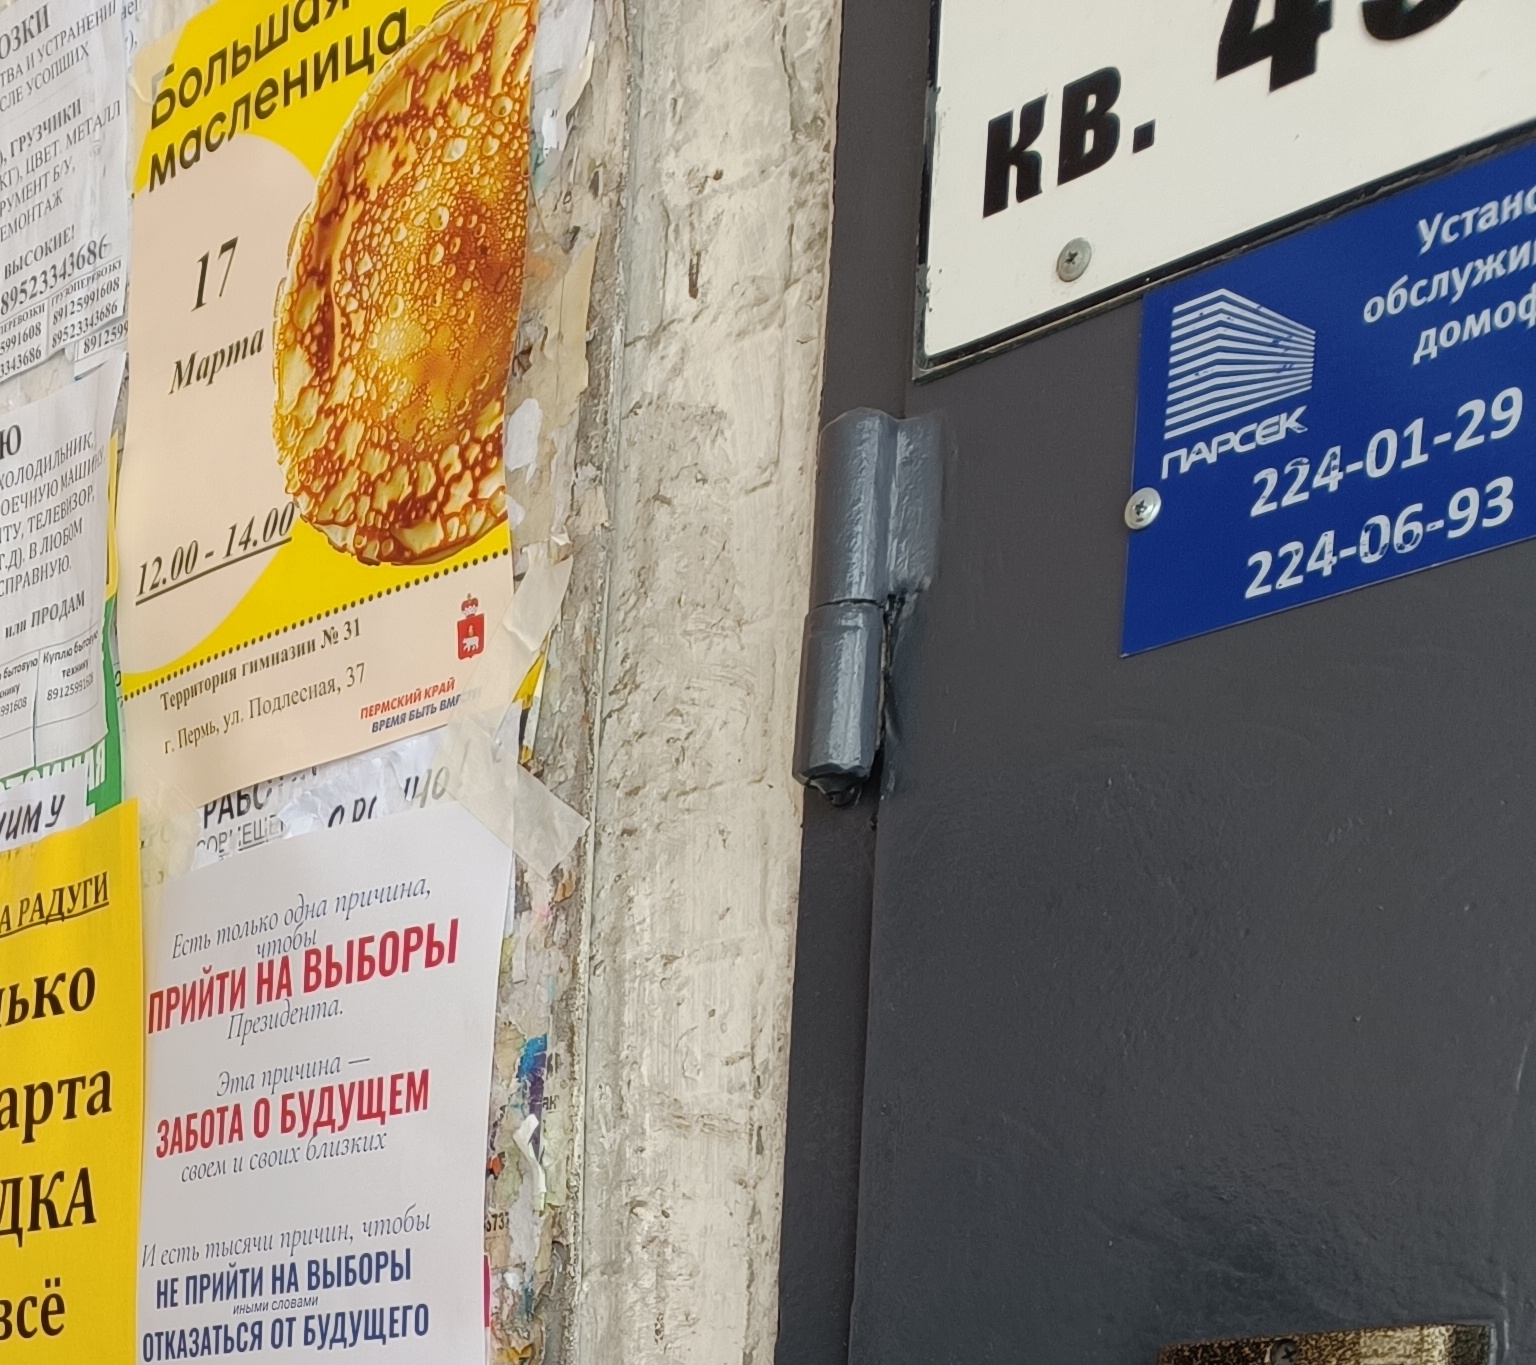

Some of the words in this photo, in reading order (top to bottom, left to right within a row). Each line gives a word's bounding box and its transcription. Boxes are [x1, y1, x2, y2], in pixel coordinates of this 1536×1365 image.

[149, 7, 408, 192] масленица
[0, 233, 113, 315] 89523343686
[4, 225, 75, 281] ВЫСОКИЕ!
[191, 236, 239, 312] 17
[1364, 239, 1536, 324] обслужи
[168, 327, 265, 395] Марта
[1162, 405, 1308, 479] ПАРСЕК
[1250, 387, 1524, 518] 224-01-29
[137, 540, 199, 598] 12.00
[224, 502, 295, 558] 14.00
[1244, 476, 1515, 599] 224-06-93
[5, 620, 26, 639] или
[31, 591, 85, 628] ПРОДАМ
[160, 654, 238, 712] Территория
[242, 638, 317, 685] гимназии
[321, 626, 339, 648] №
[343, 618, 361, 640] 31
[360, 688, 421, 720] ПЕРМСКИЙ
[424, 677, 456, 701] КРАЙ
[177, 720, 220, 750] Пермь,
[223, 707, 244, 734] ул.
[249, 676, 342, 718] Подлесная,
[346, 662, 366, 689] 37
[372, 712, 406, 734] ВРЕМЯ
[409, 702, 437, 723] БЫТЬ
[17, 872, 109, 925] РАДУГИ
[172, 932, 211, 960] Есть
[216, 909, 278, 950] только
[284, 894, 327, 930] одна
[335, 878, 431, 919] причина,
[256, 925, 317, 958] чтобы
[148, 965, 246, 1034] ПРИЙТИ
[256, 957, 293, 1005] НА
[303, 918, 459, 993] ВЫБОРЫ
[227, 998, 343, 1047] Президента.
[216, 1070, 255, 1097] Эта
[262, 1056, 342, 1095] причина
[156, 1097, 244, 1159] ЗАБОТА
[254, 1097, 271, 1138] О
[280, 1069, 430, 1138] БУДУЩЕМ
[181, 1157, 226, 1182] своем
[232, 1154, 243, 1172] и
[249, 1146, 300, 1171] своих
[306, 1125, 387, 1159] близких
[142, 1244, 157, 1268] И
[161, 1243, 200, 1266] есть
[206, 1230, 274, 1259] тысячи
[280, 1220, 354, 1259] причин,
[363, 1203, 431, 1241] чтобы
[156, 1277, 179, 1309] НЕ
[185, 1261, 263, 1306] ПРИЙТИ
[271, 1262, 299, 1296] НА
[307, 1248, 412, 1293] ВЫБОРЫ
[233, 1300, 269, 1316] иными
[271, 1295, 318, 1312] словами
[142, 1320, 263, 1362] ОТКАЗАТЬСЯ
[270, 1318, 297, 1350] ОТ
[303, 1303, 430, 1351] БУДУЩЕГО
